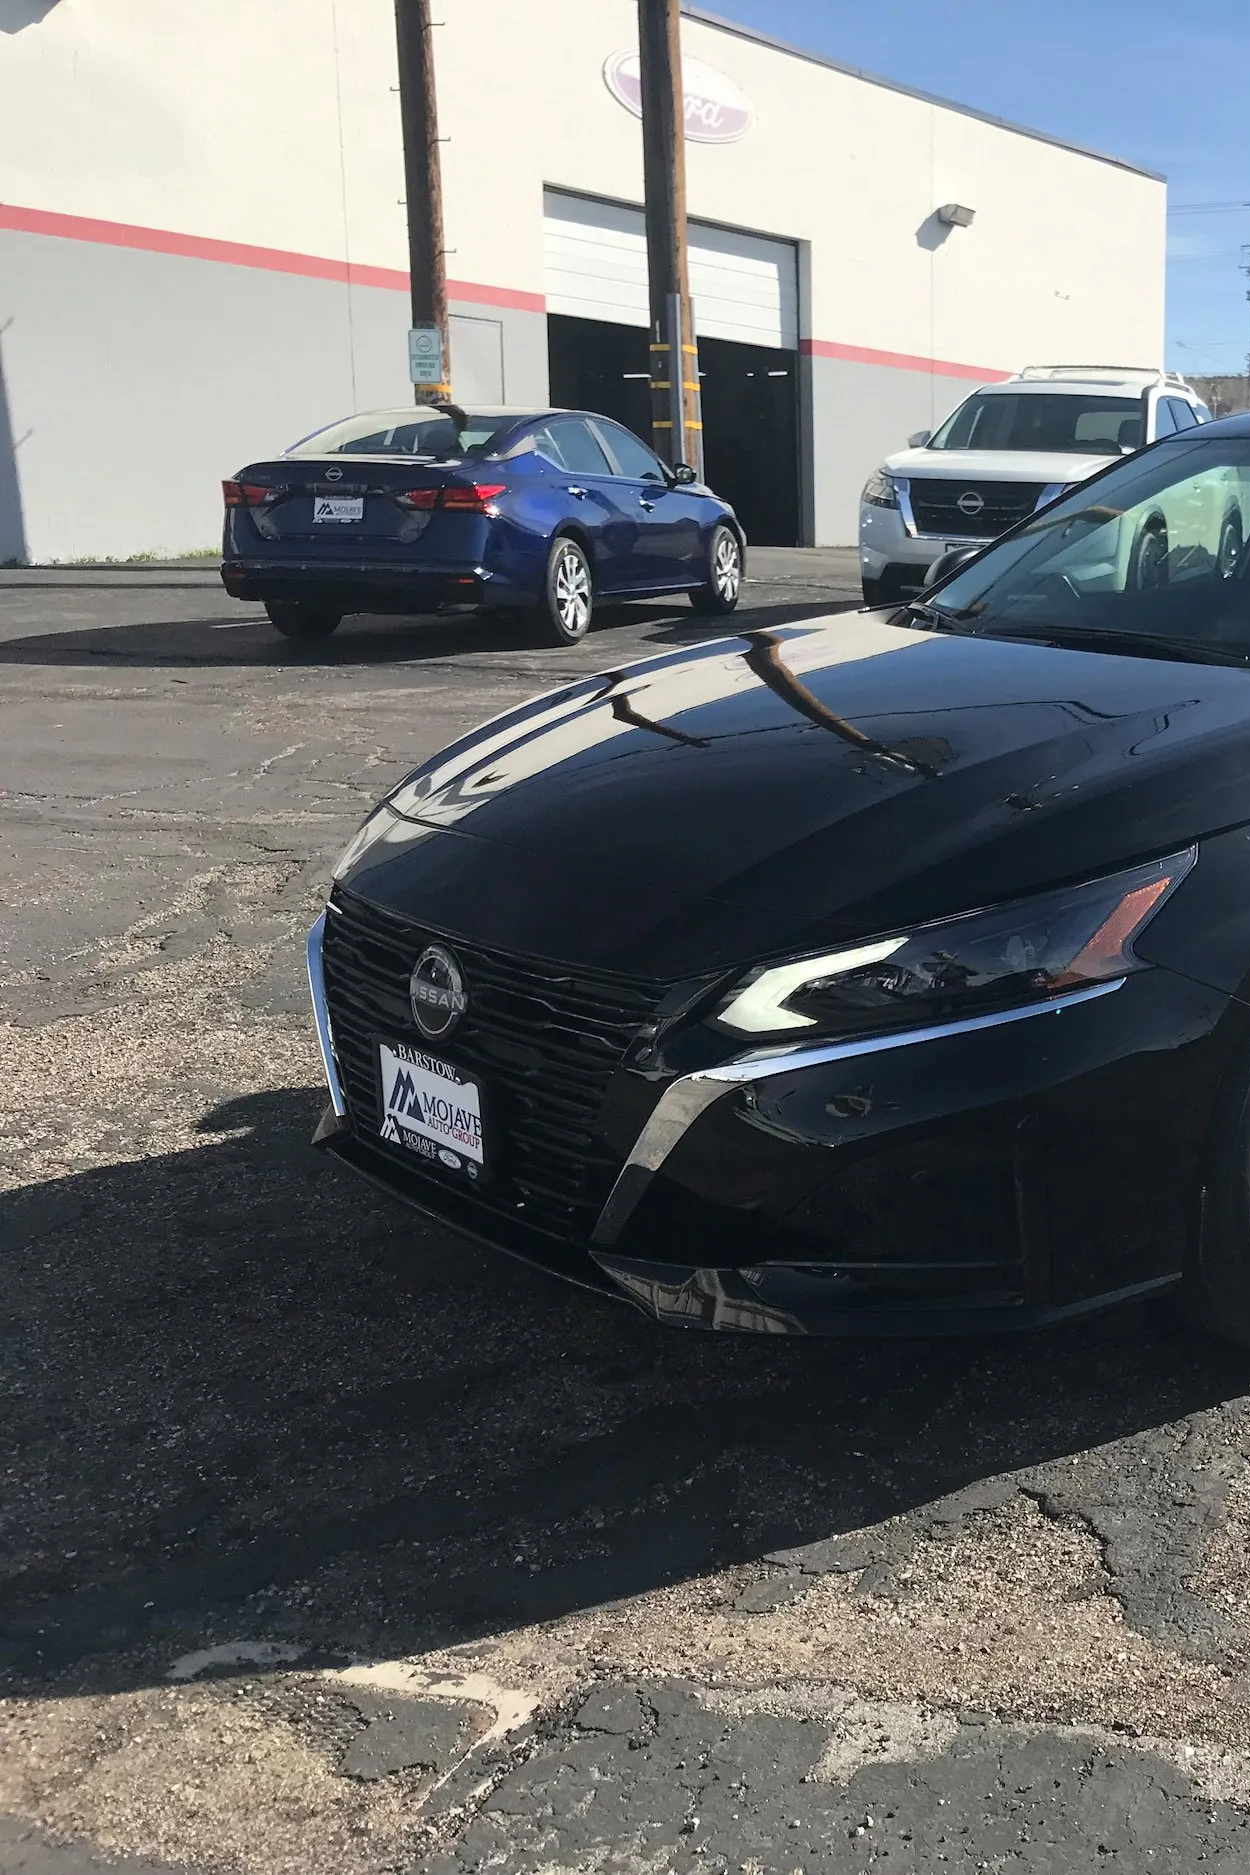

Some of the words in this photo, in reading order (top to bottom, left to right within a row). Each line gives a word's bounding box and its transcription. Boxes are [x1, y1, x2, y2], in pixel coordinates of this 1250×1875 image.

[684, 96, 724, 128] rd
[397, 1043, 456, 1081] BARSTOW
[422, 1091, 482, 1138] MOJAVE
[403, 1129, 437, 1155] MOJAVE
[428, 1117, 450, 1135] AUTO
[451, 1127, 481, 1149] GROUP
